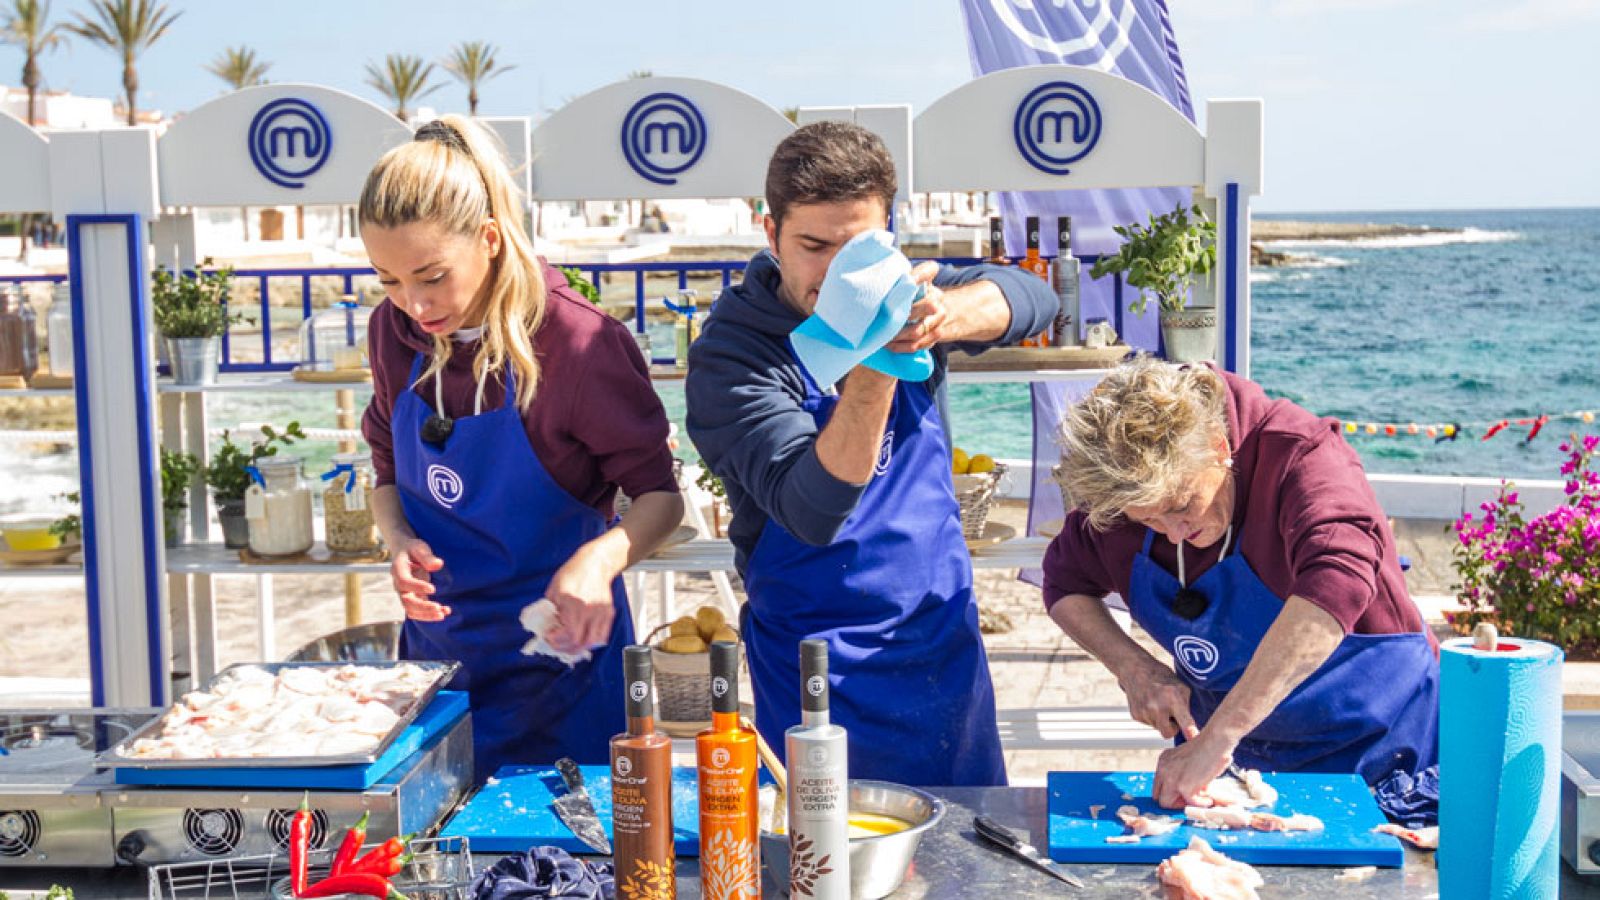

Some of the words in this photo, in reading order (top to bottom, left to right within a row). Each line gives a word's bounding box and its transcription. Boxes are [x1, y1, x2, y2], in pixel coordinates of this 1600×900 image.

[801, 778, 834, 786] ACEITE
[796, 785, 809, 794] DE
[812, 785, 841, 795] OLIVA
[704, 795, 740, 803] VIRGEN
[799, 794, 838, 803] VIRGEN
[707, 803, 739, 812] EXTRA
[803, 802, 836, 811] EXTRA
